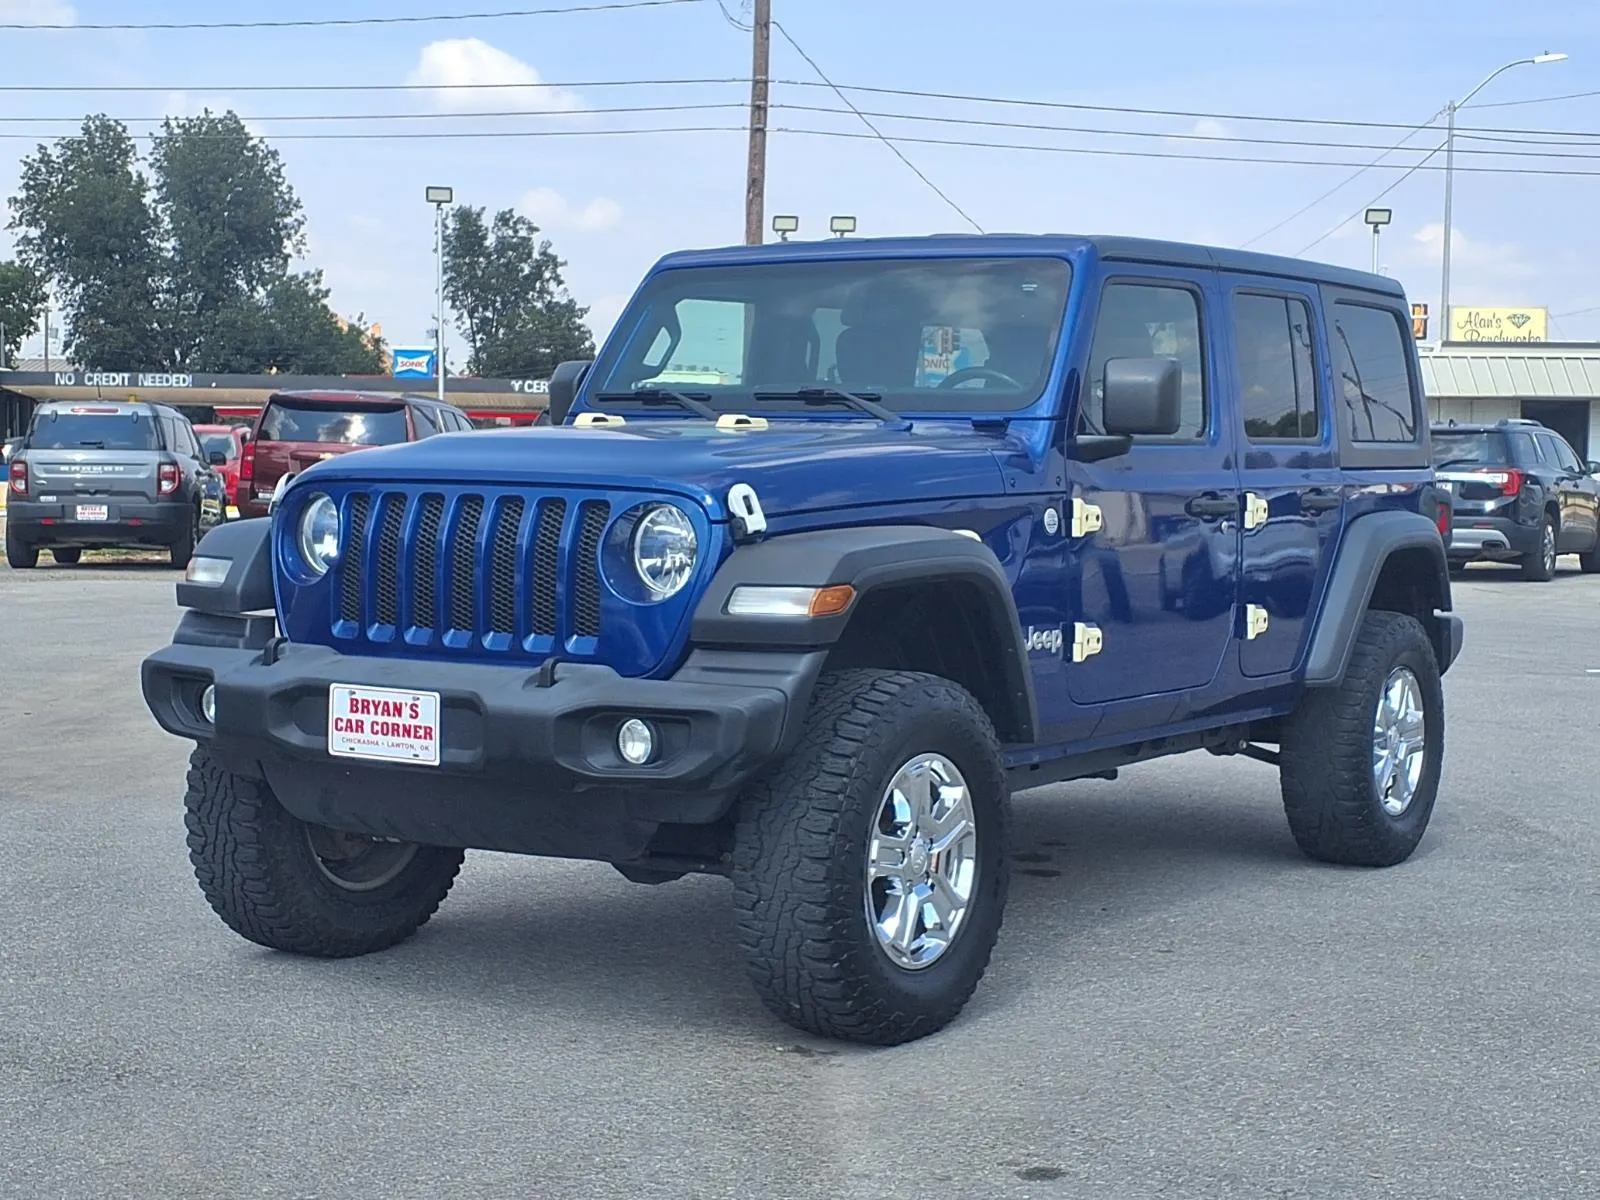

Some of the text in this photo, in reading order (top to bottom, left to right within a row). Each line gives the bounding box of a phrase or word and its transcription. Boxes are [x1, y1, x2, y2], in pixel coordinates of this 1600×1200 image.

[1456, 311, 1502, 330] Alan's
[399, 359, 425, 368] SONIC
[54, 372, 193, 387] NO CREDIT NEEDED!
[1024, 625, 1062, 653] Jeep
[349, 697, 419, 720] BRYAN'S
[334, 717, 434, 741] CAR CORNER
[341, 736, 380, 747] CHICKASHA
[386, 741, 417, 752] LAWTON,
